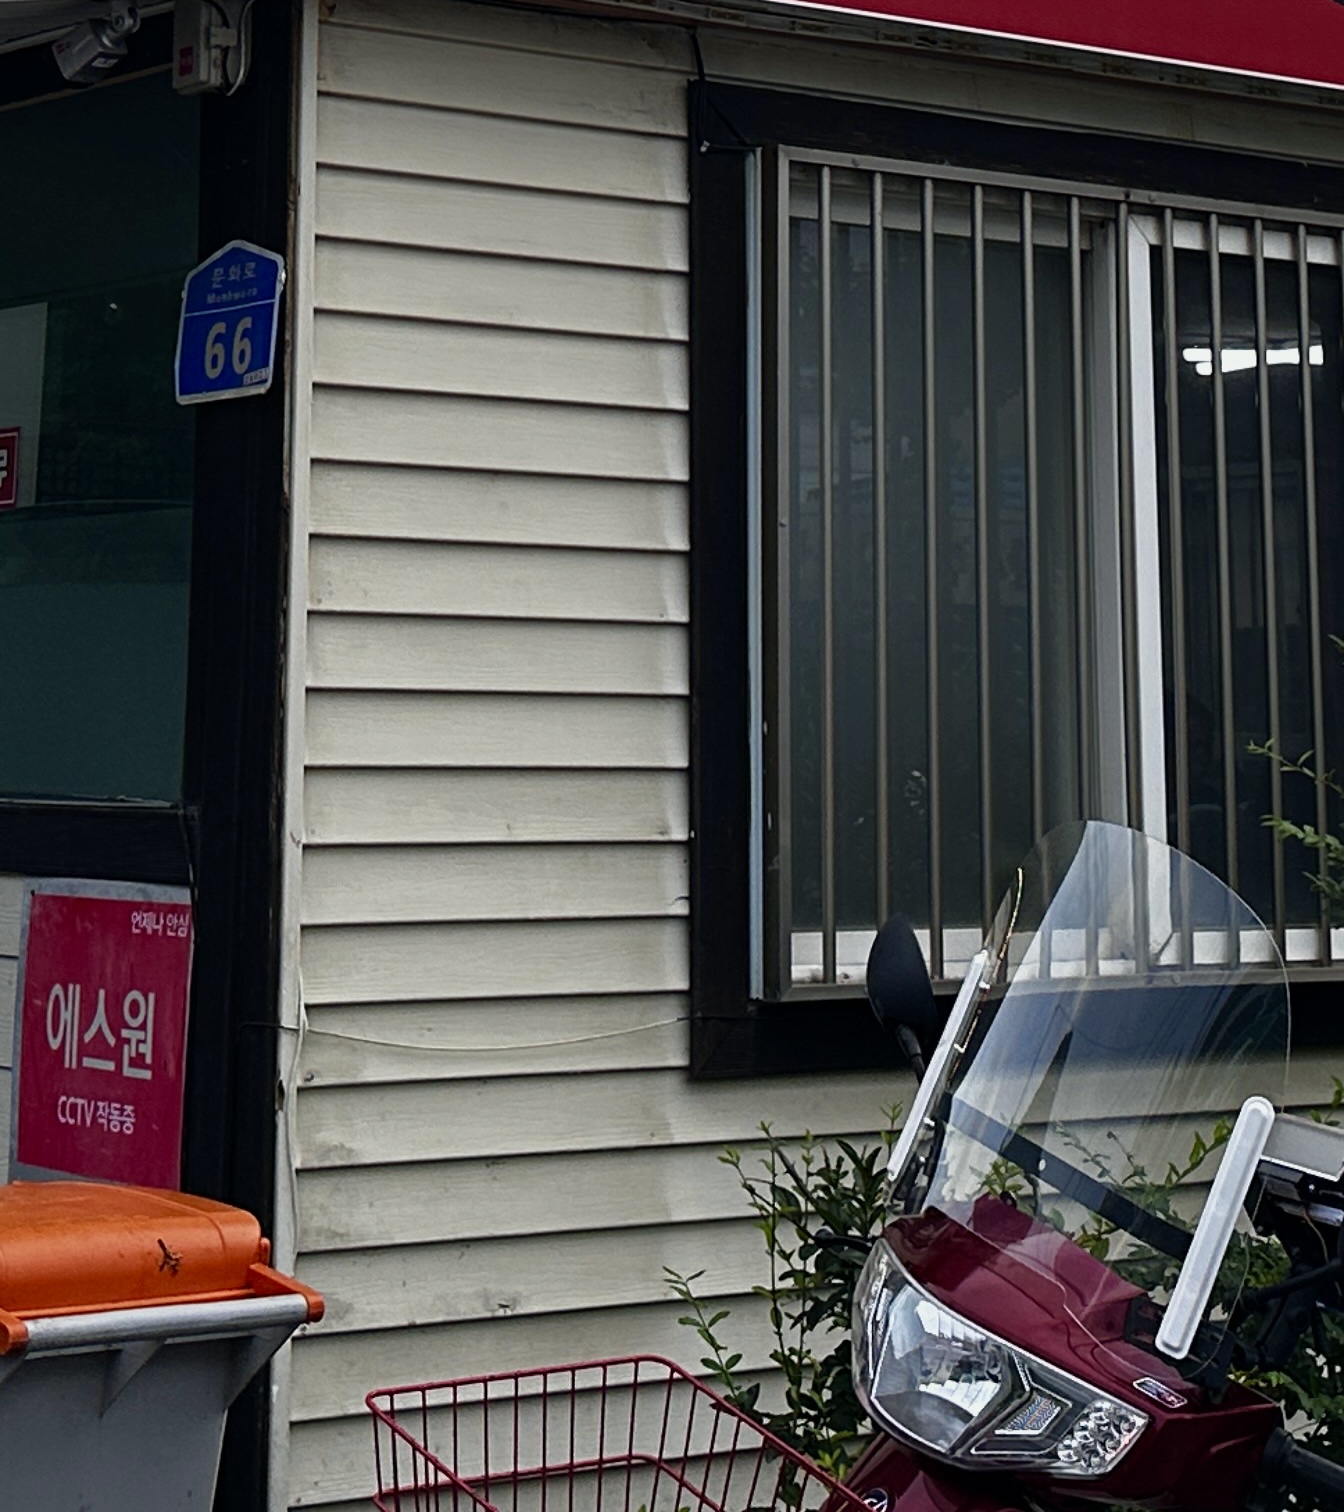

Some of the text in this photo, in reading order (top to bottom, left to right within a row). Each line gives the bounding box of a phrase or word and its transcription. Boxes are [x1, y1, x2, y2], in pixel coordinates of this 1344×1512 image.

[212, 262, 256, 288] 문화로
[205, 317, 252, 379] 66
[131, 910, 190, 938] 언제나 안심
[46, 982, 156, 1081] 에스원
[57, 1095, 137, 1135] CCTV 작동중
